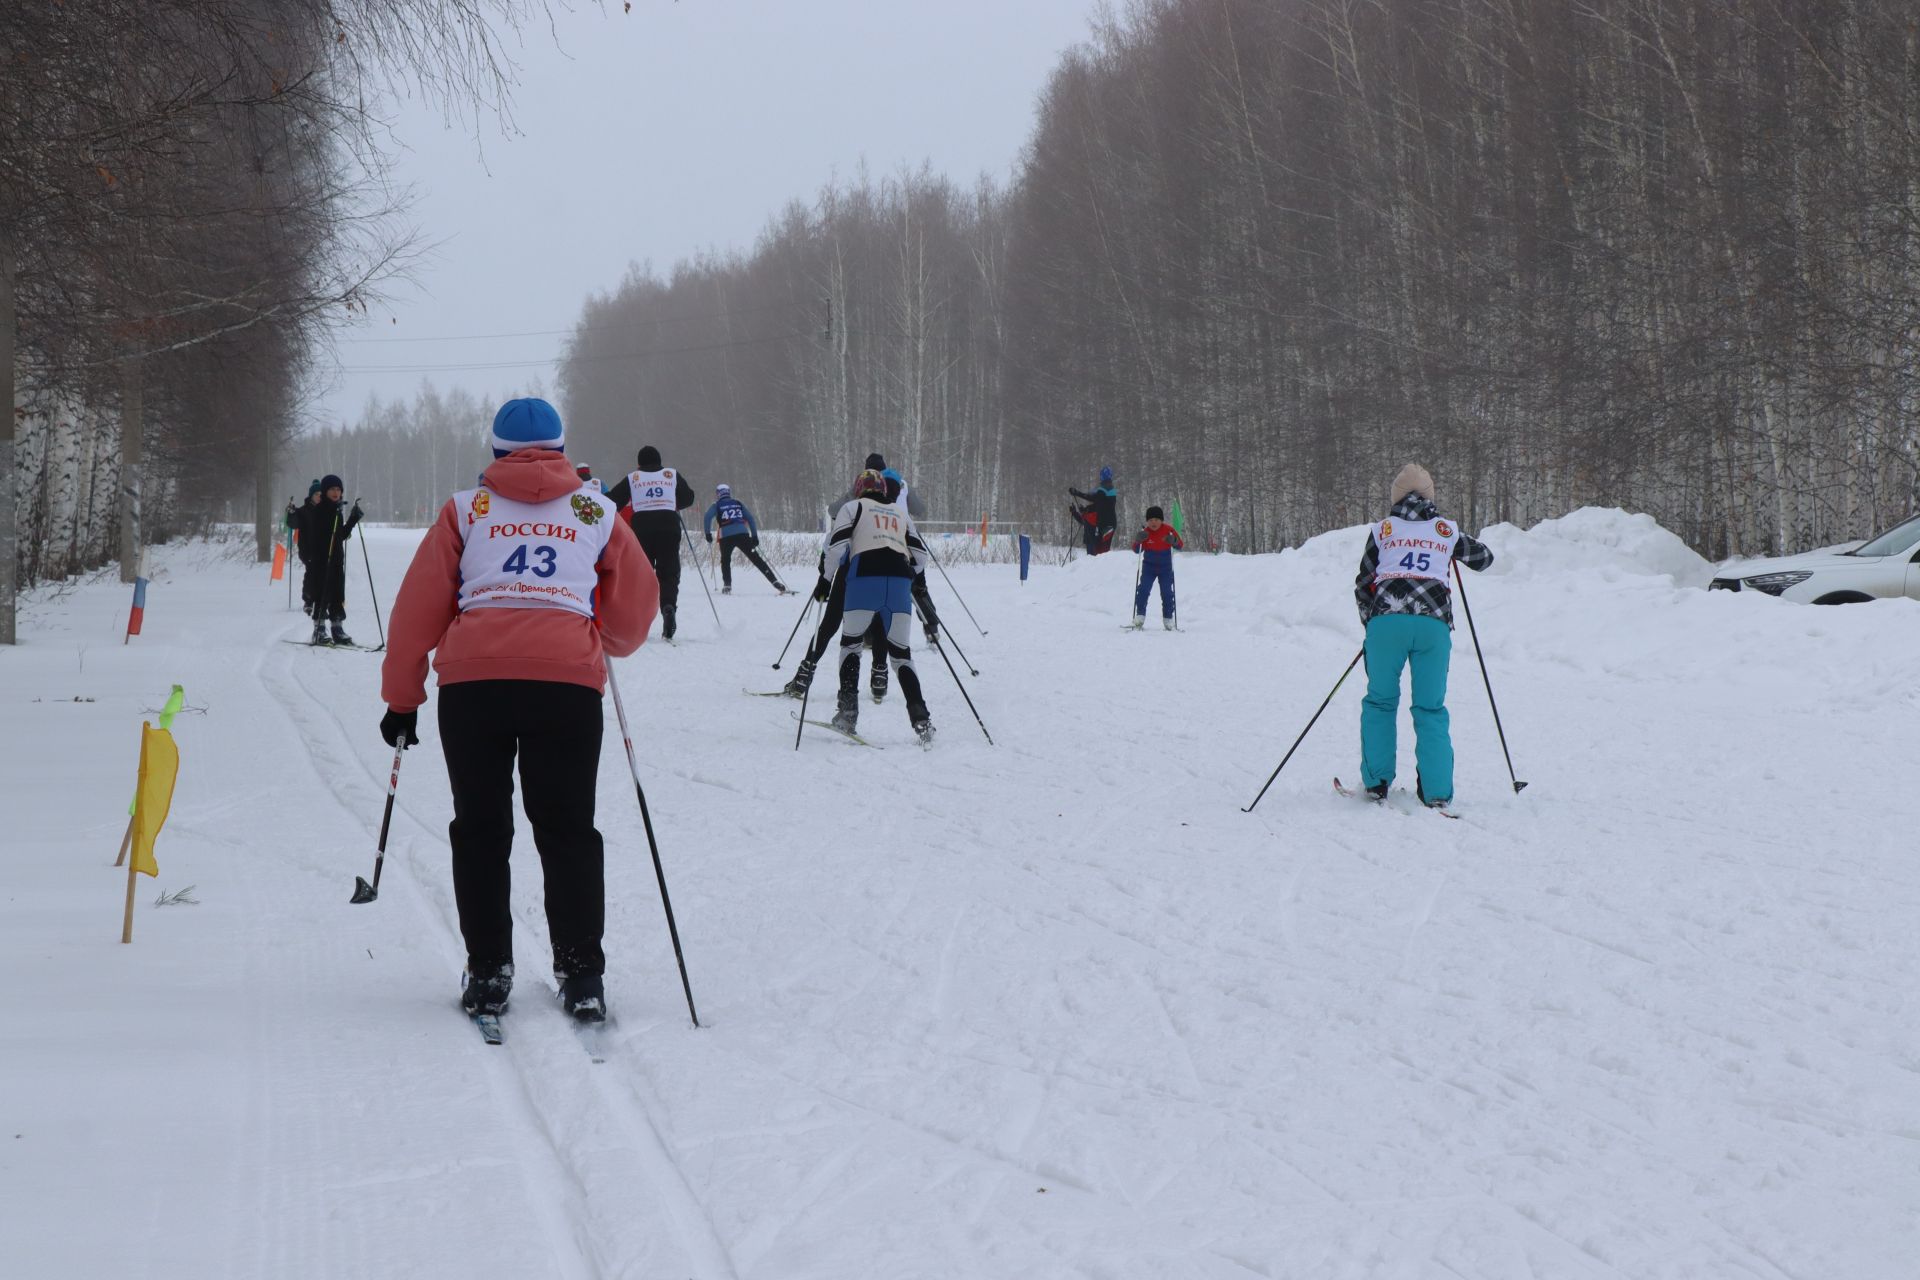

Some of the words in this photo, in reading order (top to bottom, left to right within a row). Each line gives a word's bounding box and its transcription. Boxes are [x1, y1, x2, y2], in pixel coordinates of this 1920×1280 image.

[645, 487, 664, 498] 49
[721, 508, 743, 520] 423
[874, 513, 899, 533] 174
[489, 523, 577, 543] РОССИЯ
[1384, 538, 1449, 555] ТАТАРСТАН
[502, 544, 557, 578] 43
[1399, 552, 1430, 572] 45
